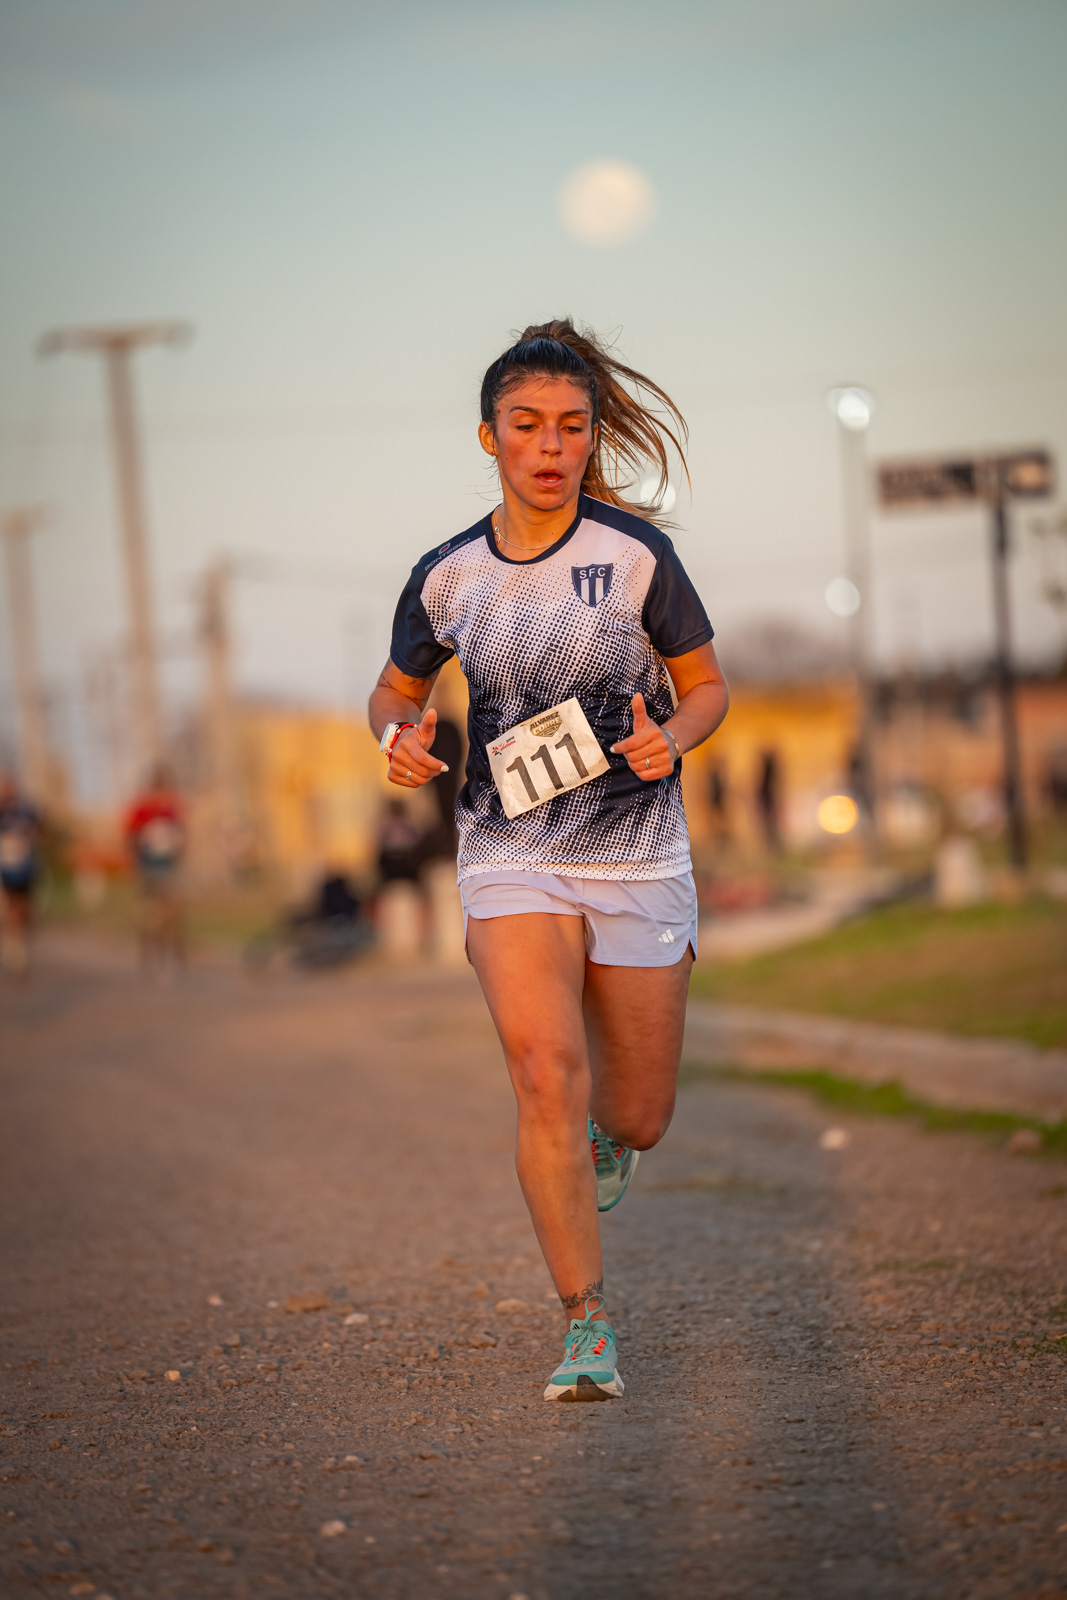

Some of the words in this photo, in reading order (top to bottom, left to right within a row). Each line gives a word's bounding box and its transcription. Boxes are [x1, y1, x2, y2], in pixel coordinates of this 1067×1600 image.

[579, 567, 606, 580] SFC
[530, 711, 560, 730] ALVAREZ
[533, 717, 561, 734] CORRE
[505, 732, 589, 803] 111
